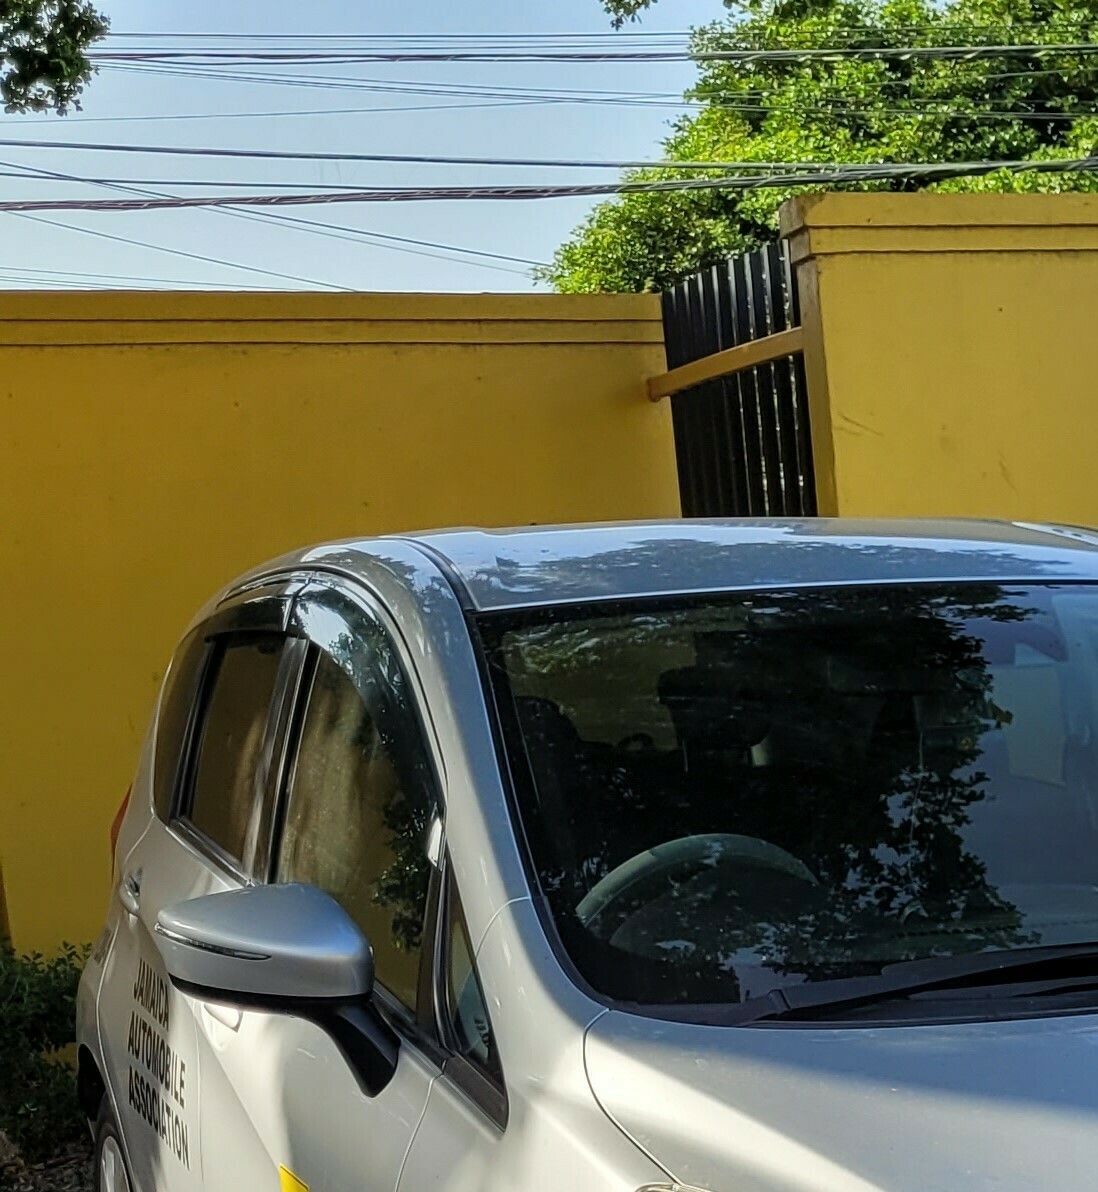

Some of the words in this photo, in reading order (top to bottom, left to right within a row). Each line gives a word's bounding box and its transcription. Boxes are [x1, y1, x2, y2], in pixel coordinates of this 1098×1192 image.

[133, 957, 170, 1031] JAMAICA
[128, 1010, 186, 1110] AUTOMOBILE
[129, 1065, 190, 1171] ASSOCIATION
